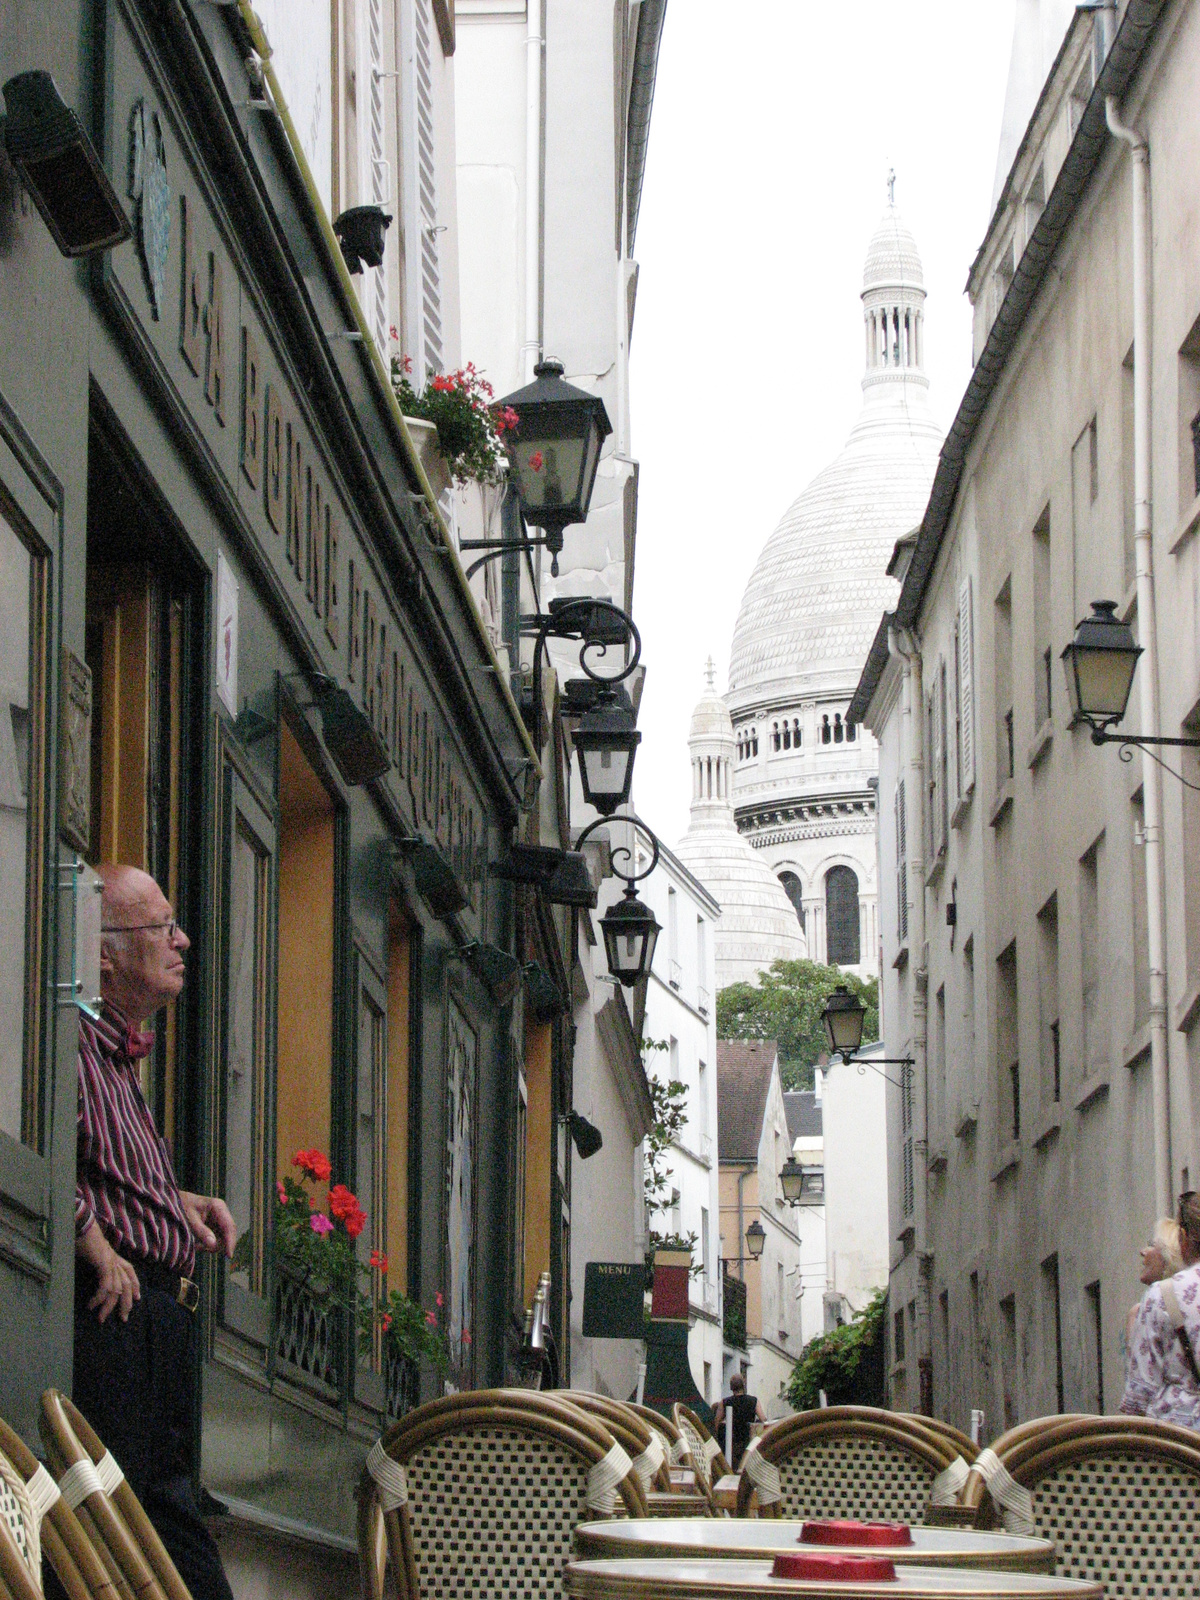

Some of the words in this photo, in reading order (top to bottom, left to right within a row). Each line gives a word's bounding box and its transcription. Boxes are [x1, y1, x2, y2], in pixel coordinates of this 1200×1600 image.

[179, 195, 225, 427] LA
[239, 321, 342, 650] BONNE
[598, 1265, 631, 1275] MENU
